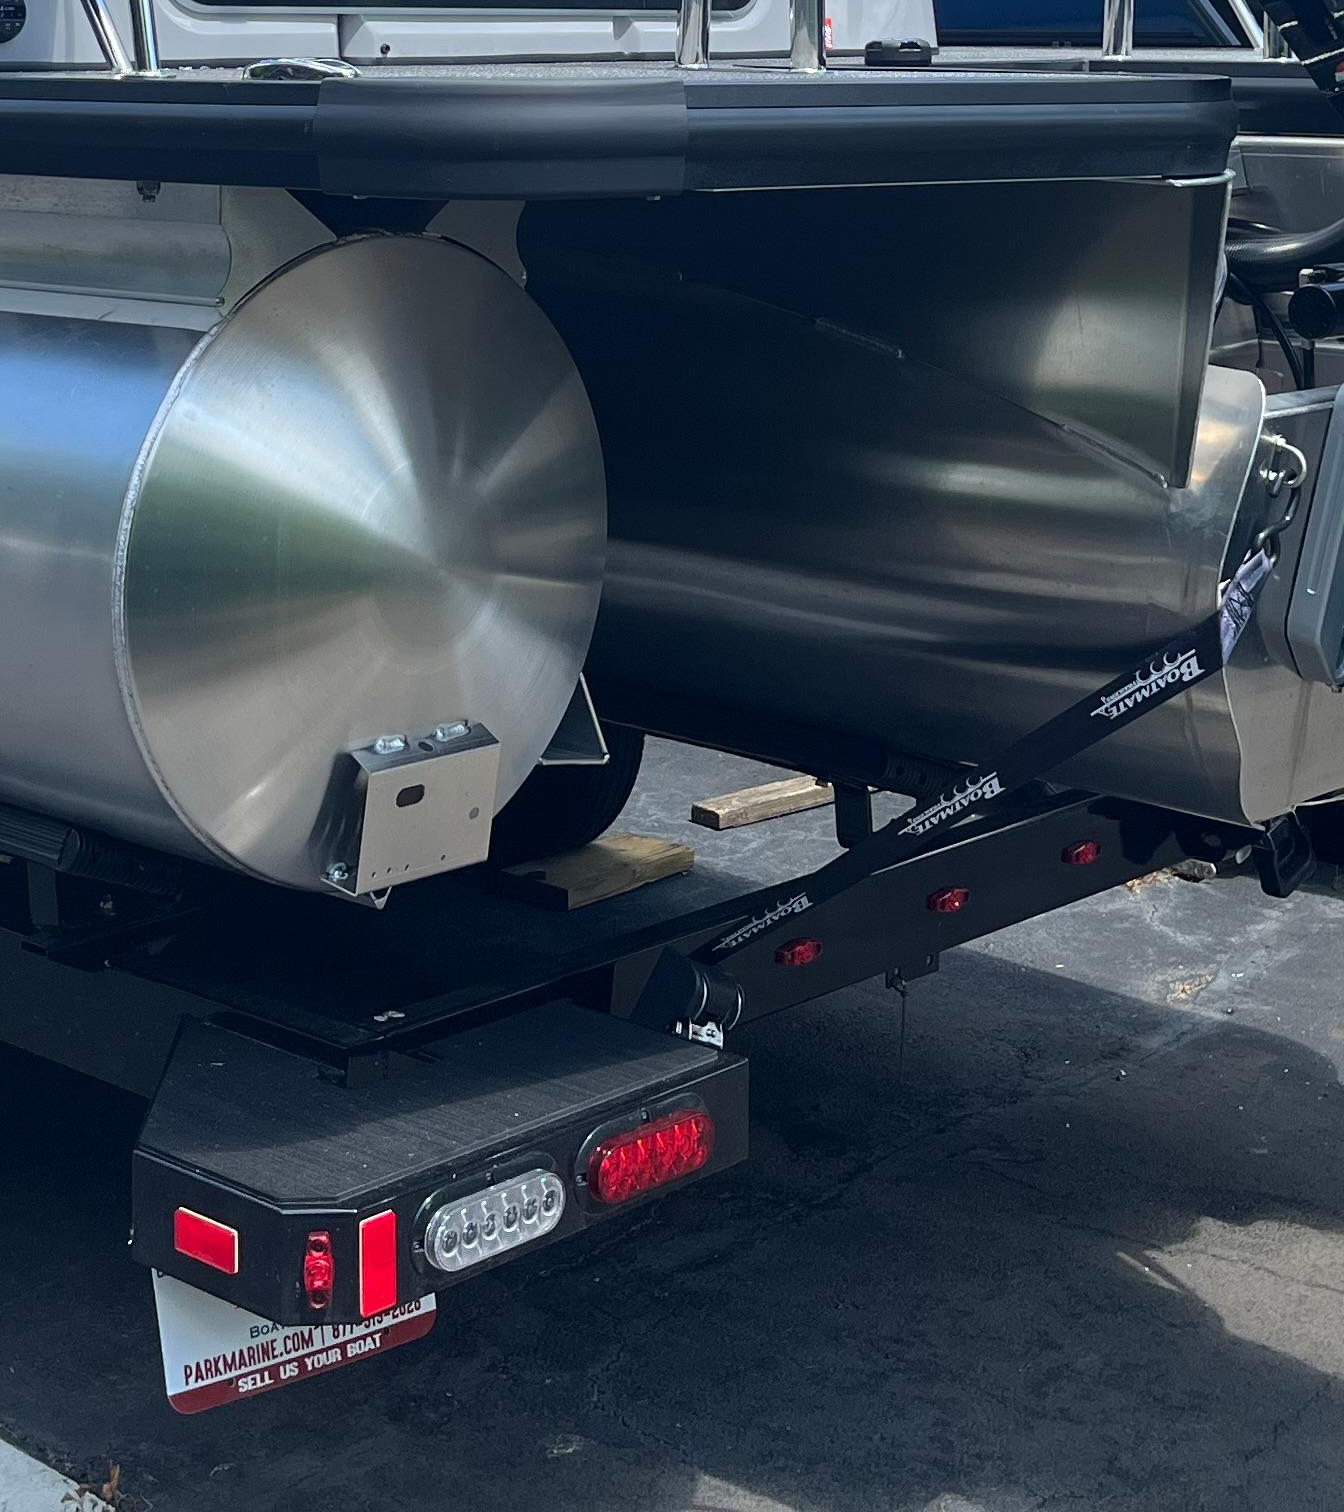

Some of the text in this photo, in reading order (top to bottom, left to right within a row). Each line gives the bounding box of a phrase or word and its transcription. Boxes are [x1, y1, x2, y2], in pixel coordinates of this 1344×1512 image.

[1107, 655, 1205, 720] BOATMATE
[915, 777, 1007, 836] BOATMATE
[183, 1327, 315, 1386] PARKMARINE.COM
[250, 1323, 287, 1339] BOA
[238, 1333, 382, 1392] SELL US YOUR BOAT
